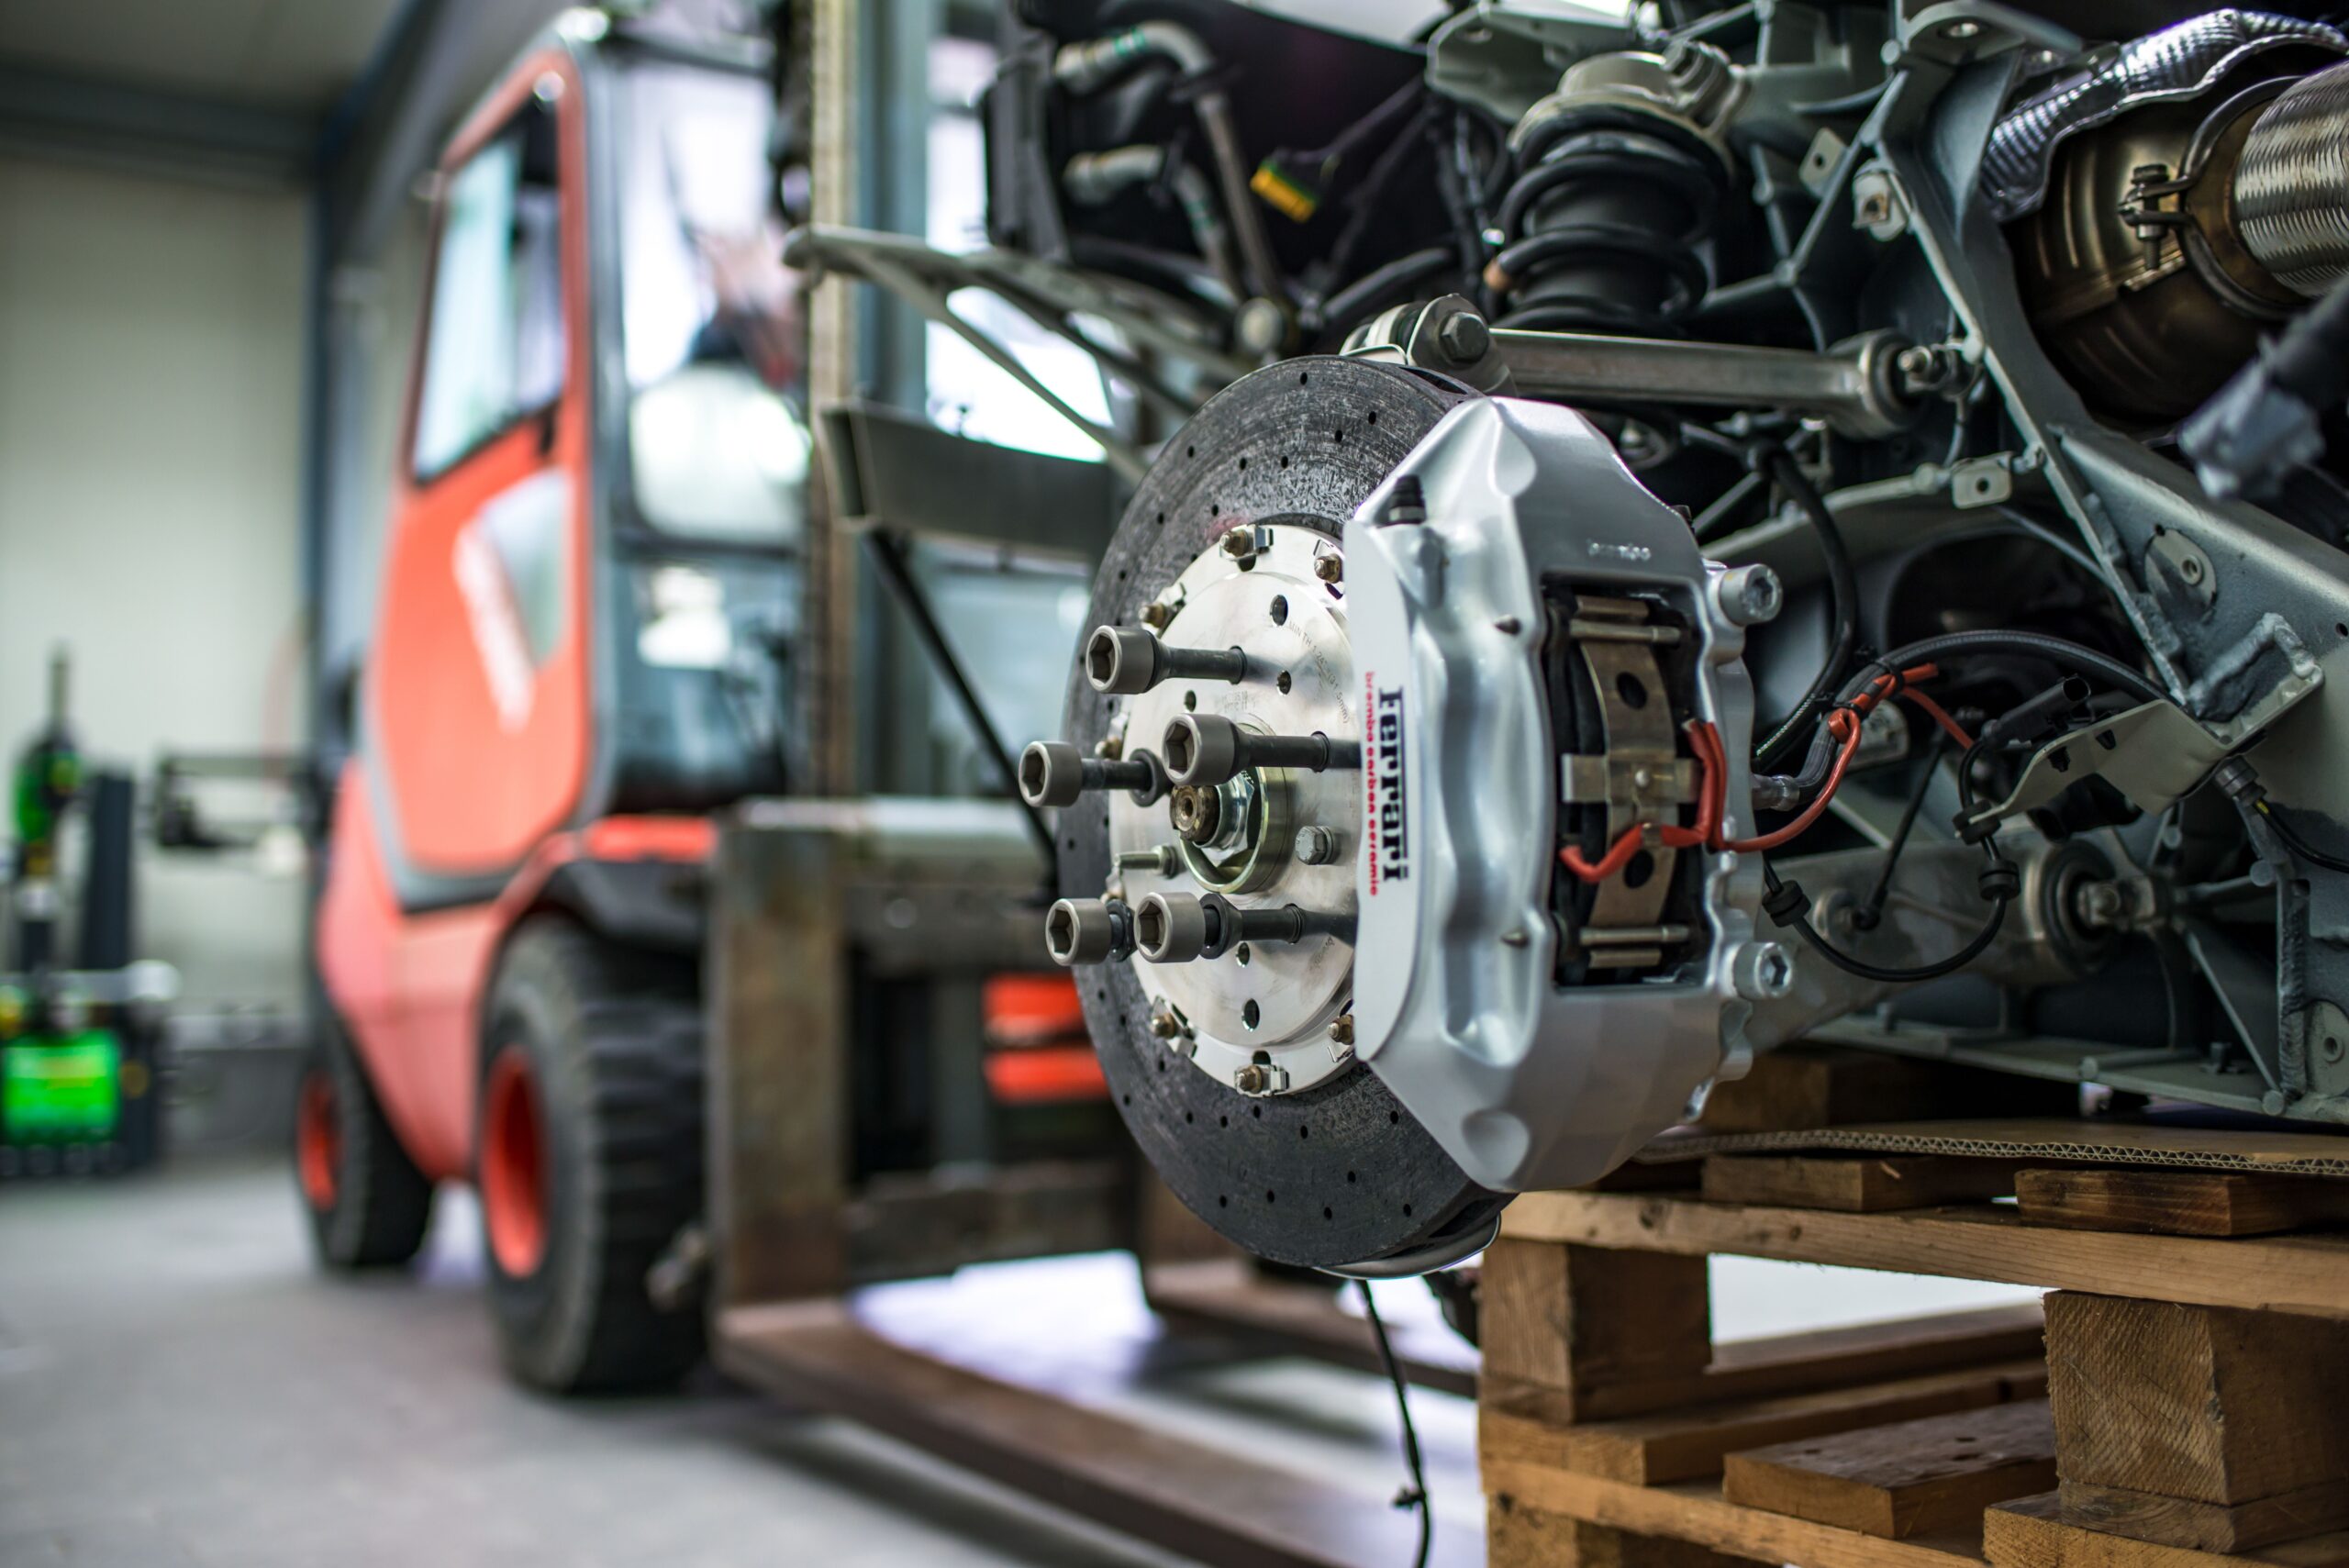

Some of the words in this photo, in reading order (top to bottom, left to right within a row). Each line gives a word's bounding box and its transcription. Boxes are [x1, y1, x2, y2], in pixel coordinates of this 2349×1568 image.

[1364, 671, 1376, 742] brembo
[1366, 747, 1377, 814] carbon
[1379, 685, 1408, 882] Ferrari
[1368, 819, 1379, 896] ceramic
